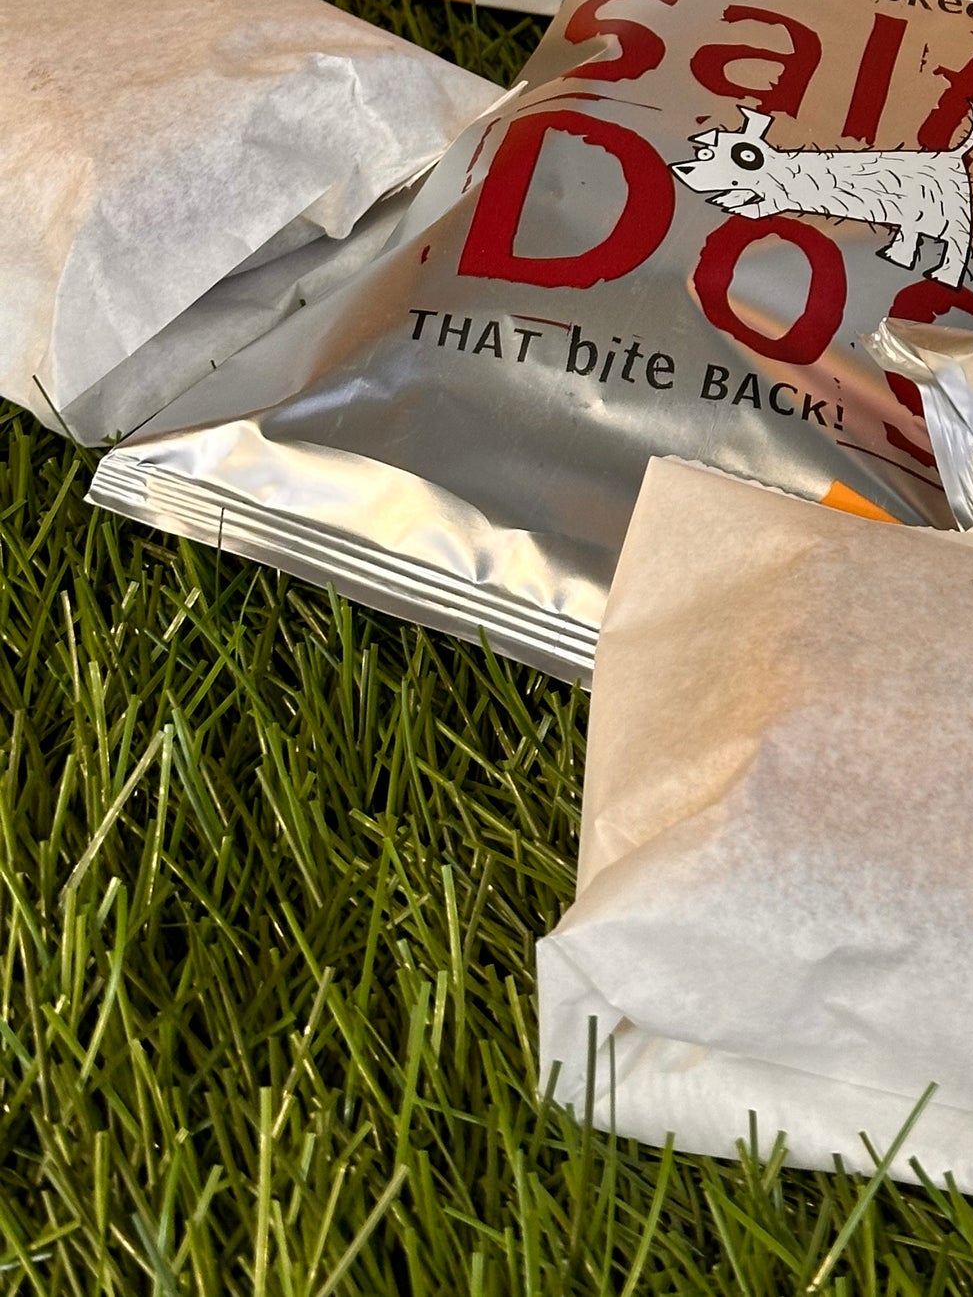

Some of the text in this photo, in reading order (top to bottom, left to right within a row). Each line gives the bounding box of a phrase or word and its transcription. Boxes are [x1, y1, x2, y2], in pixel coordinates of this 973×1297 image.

[408, 308, 846, 432] THAT bite BACK!
